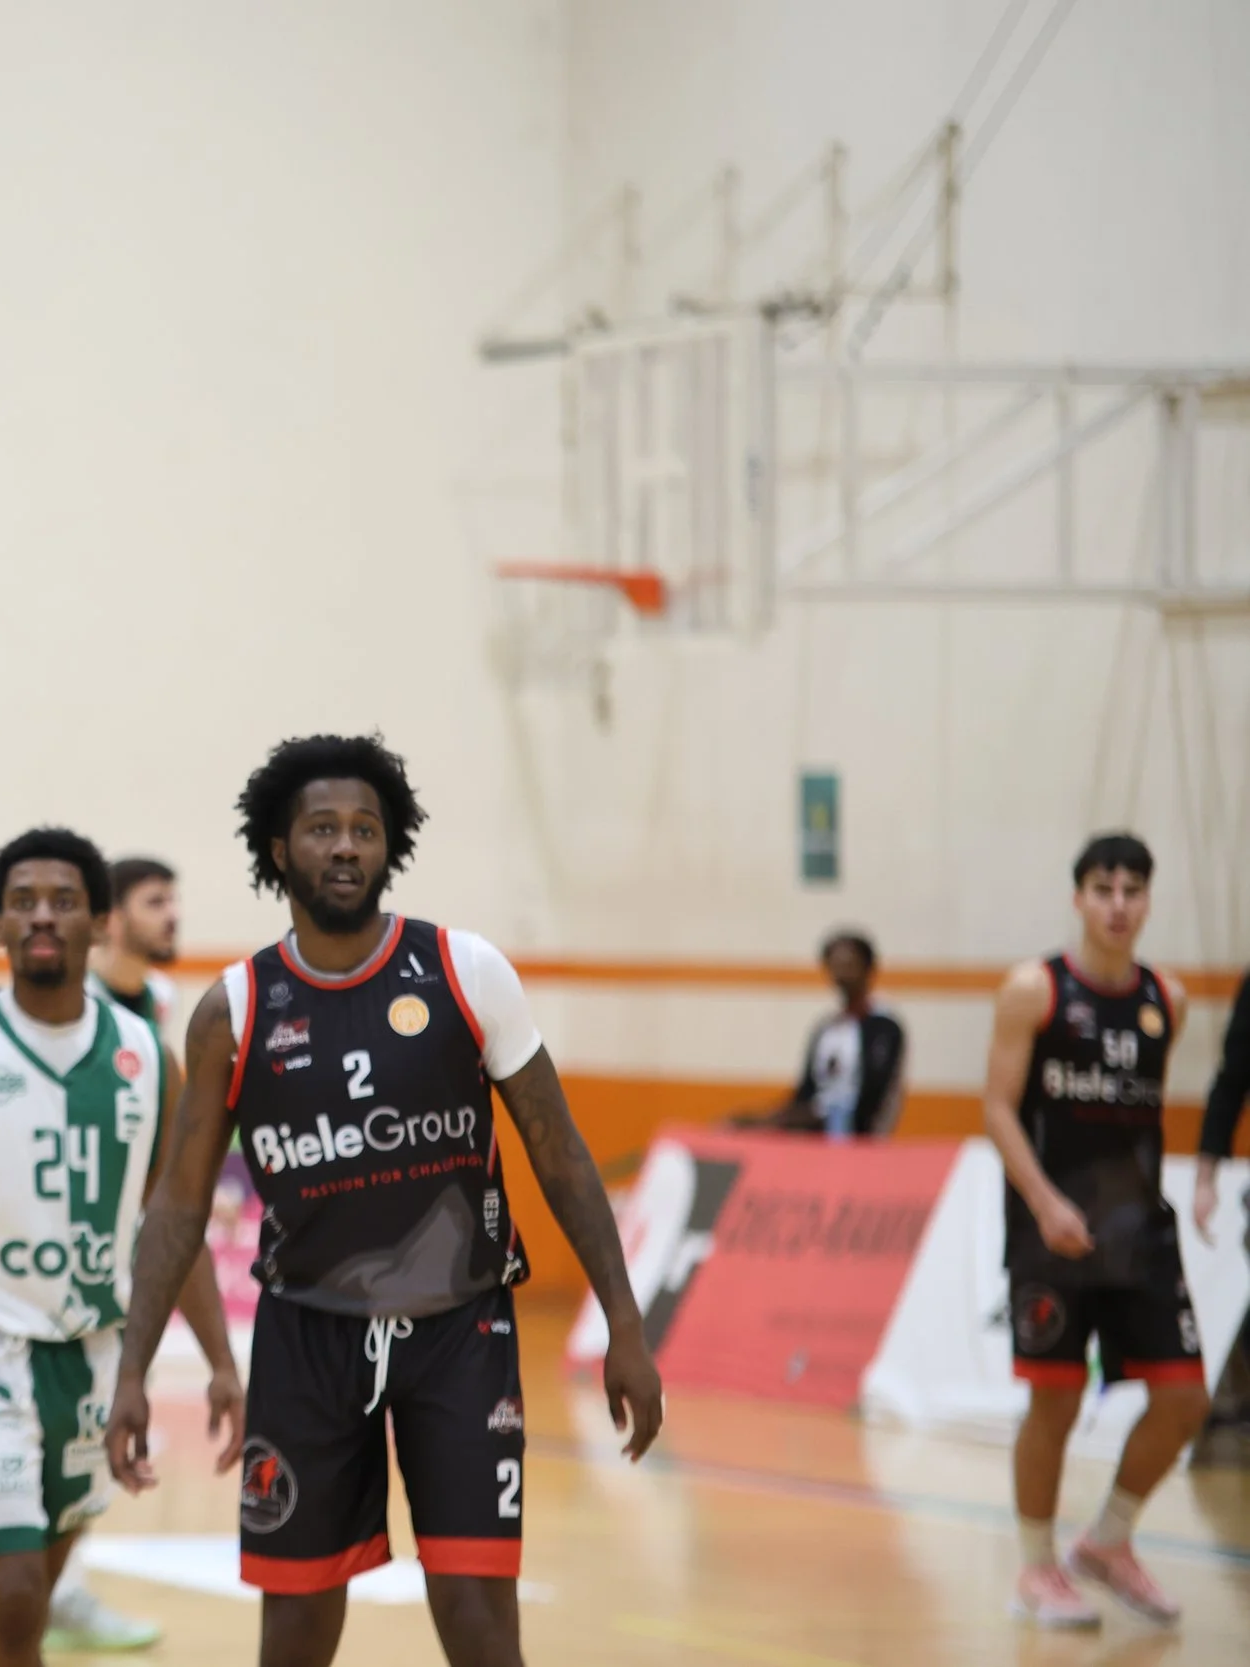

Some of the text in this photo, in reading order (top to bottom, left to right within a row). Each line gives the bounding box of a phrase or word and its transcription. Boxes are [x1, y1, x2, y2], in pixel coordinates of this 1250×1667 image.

[342, 1050, 375, 1101] 2
[34, 1126, 99, 1204] 24
[301, 1176, 365, 1200] PASSION
[371, 1168, 402, 1187] FOR
[496, 1458, 520, 1518] 2
